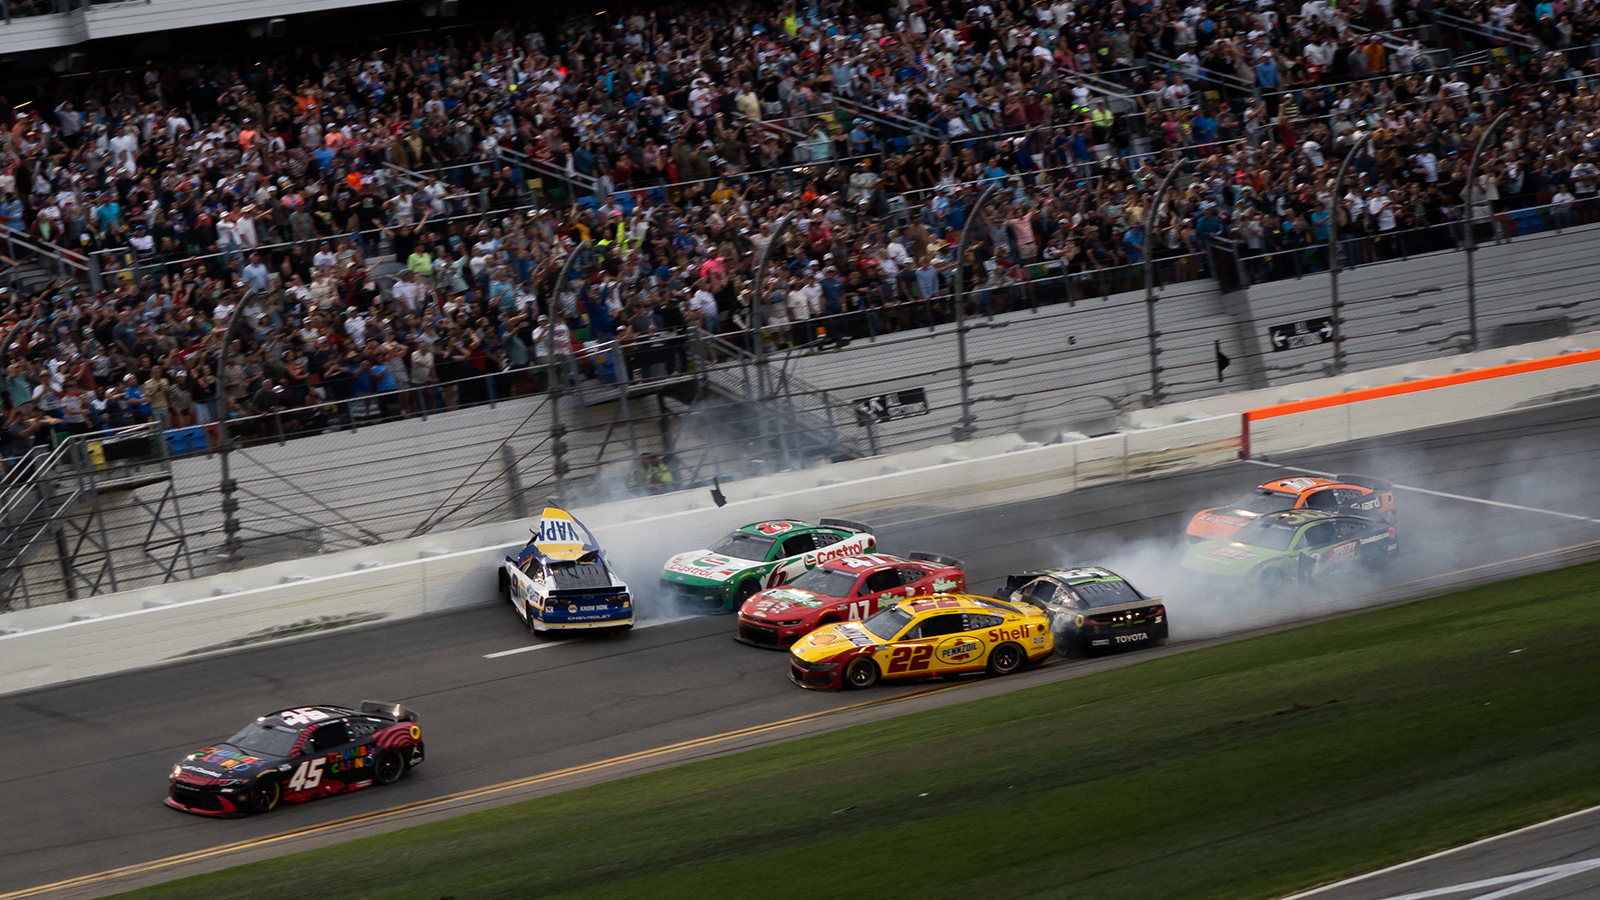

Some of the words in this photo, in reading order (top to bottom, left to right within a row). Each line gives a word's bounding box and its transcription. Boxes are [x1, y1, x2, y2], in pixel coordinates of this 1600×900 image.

[766, 561, 788, 589] 6
[848, 599, 870, 621] 47
[988, 624, 1030, 643] Shell
[1115, 632, 1149, 644] TOYOTA
[887, 644, 934, 674] 22
[941, 641, 979, 658] PENNZOIL
[288, 757, 328, 792] 45
[331, 755, 375, 774] CASINO
